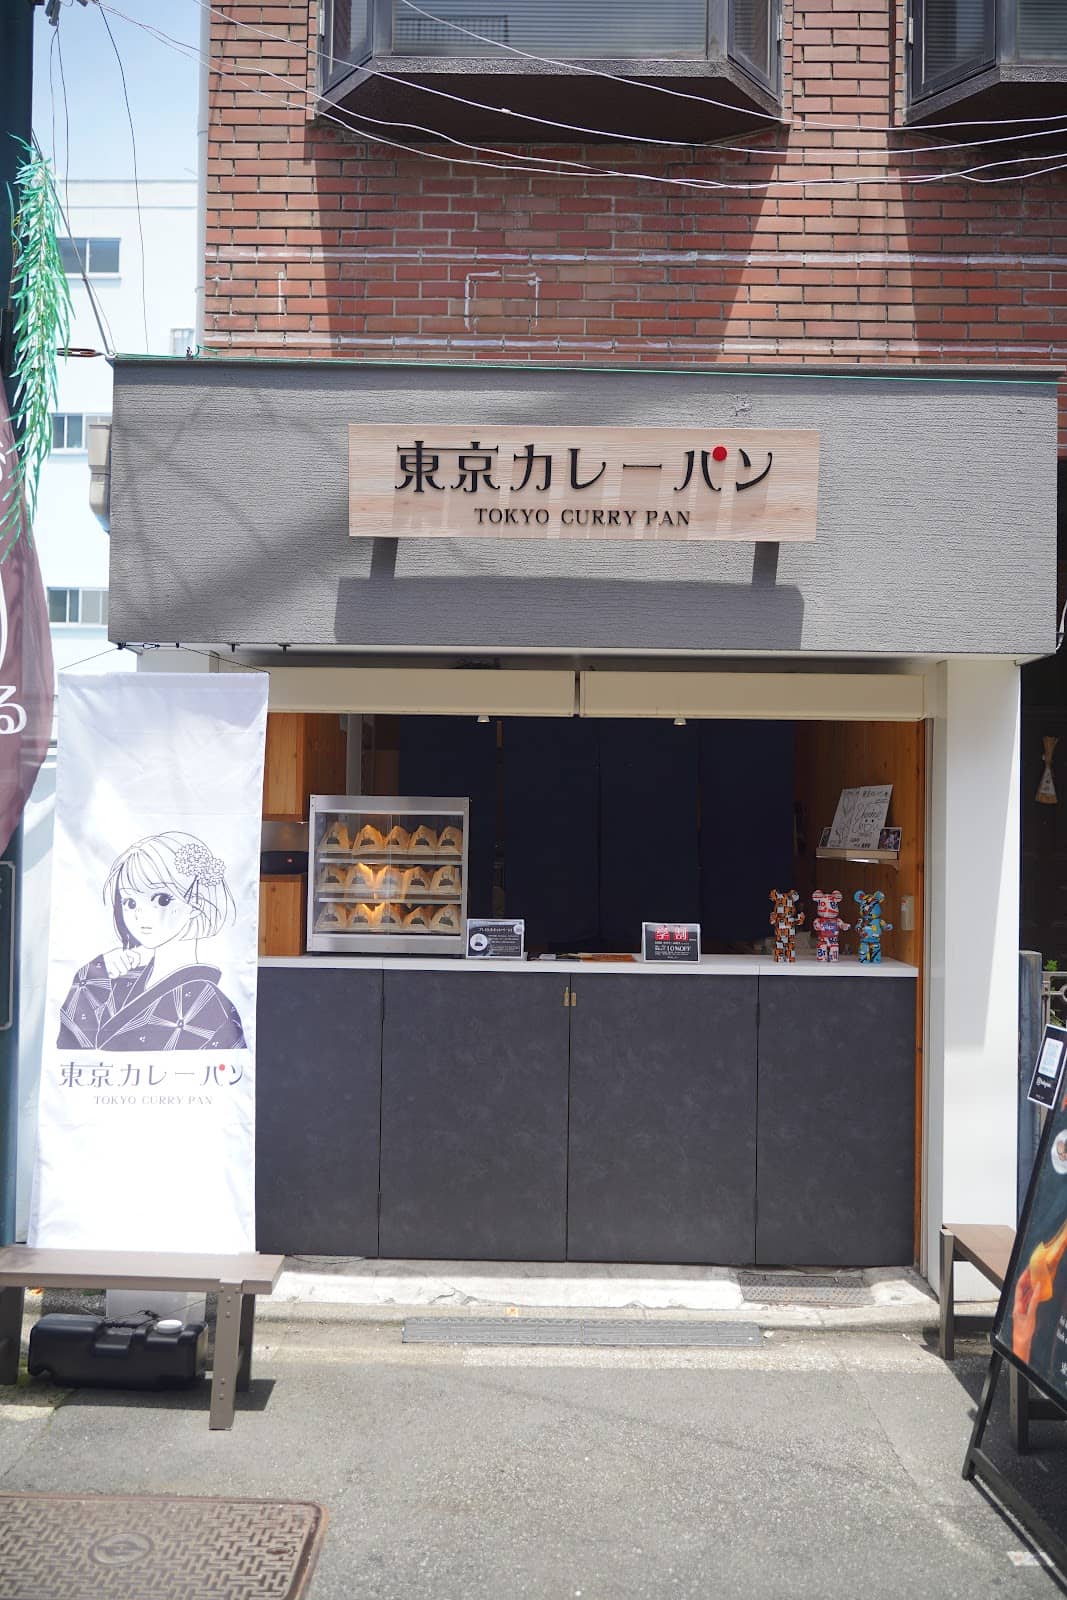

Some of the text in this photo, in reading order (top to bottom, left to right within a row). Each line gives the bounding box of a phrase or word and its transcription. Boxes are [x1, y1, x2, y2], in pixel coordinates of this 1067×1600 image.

[394, 441, 773, 493] 東京カレーパン
[474, 507, 691, 527] TOKYO CURRY PAN
[58, 1061, 244, 1088] 東京カレーパン
[94, 1096, 213, 1105] TOKYO CURRY PAN
